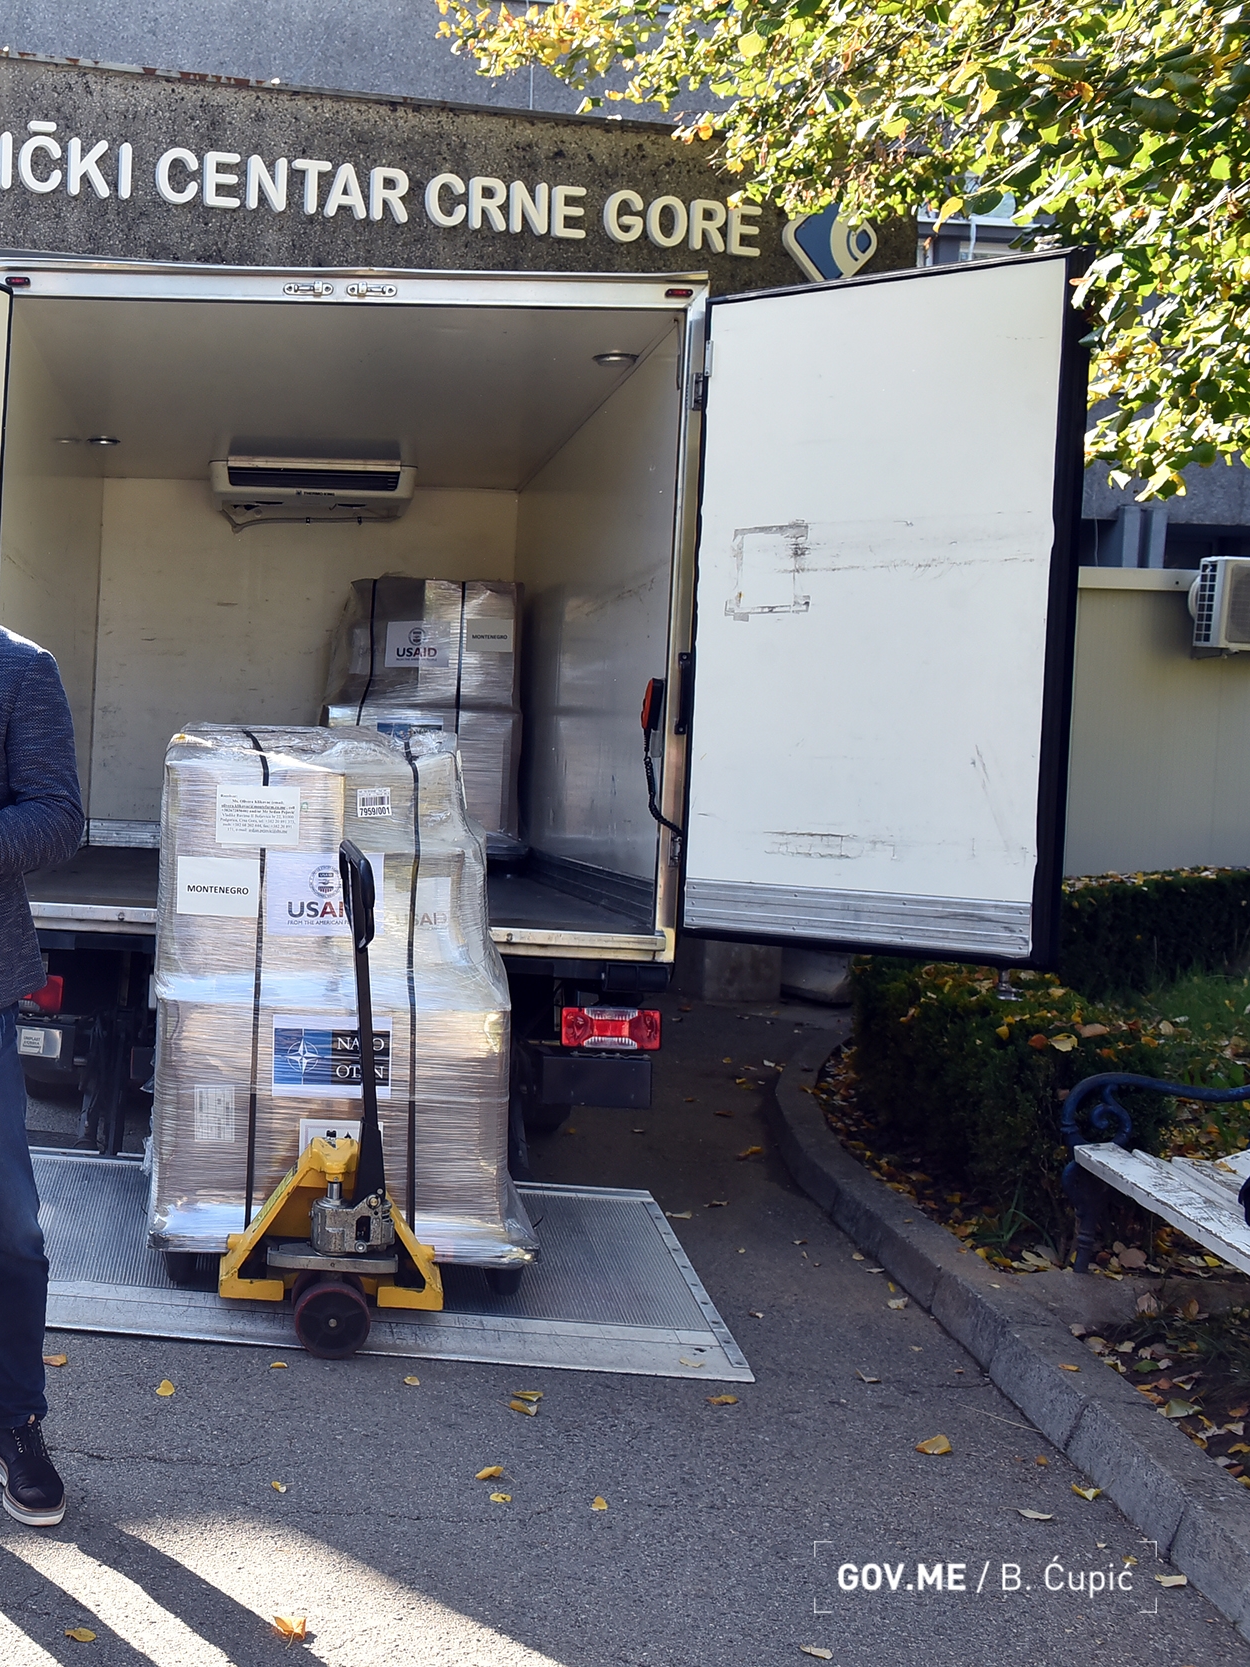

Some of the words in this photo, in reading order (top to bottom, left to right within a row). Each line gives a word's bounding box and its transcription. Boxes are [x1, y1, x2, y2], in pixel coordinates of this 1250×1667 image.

[155, 146, 410, 226] CENTAR
[424, 172, 588, 240] CRNE
[603, 188, 762, 258] GORE
[396, 647, 438, 658] USAID
[359, 806, 390, 816] 7959/001
[187, 884, 249, 895] MONTENEGRO
[288, 901, 344, 918] USAI
[337, 1037, 385, 1051] NAO
[336, 1064, 385, 1078] OTN
